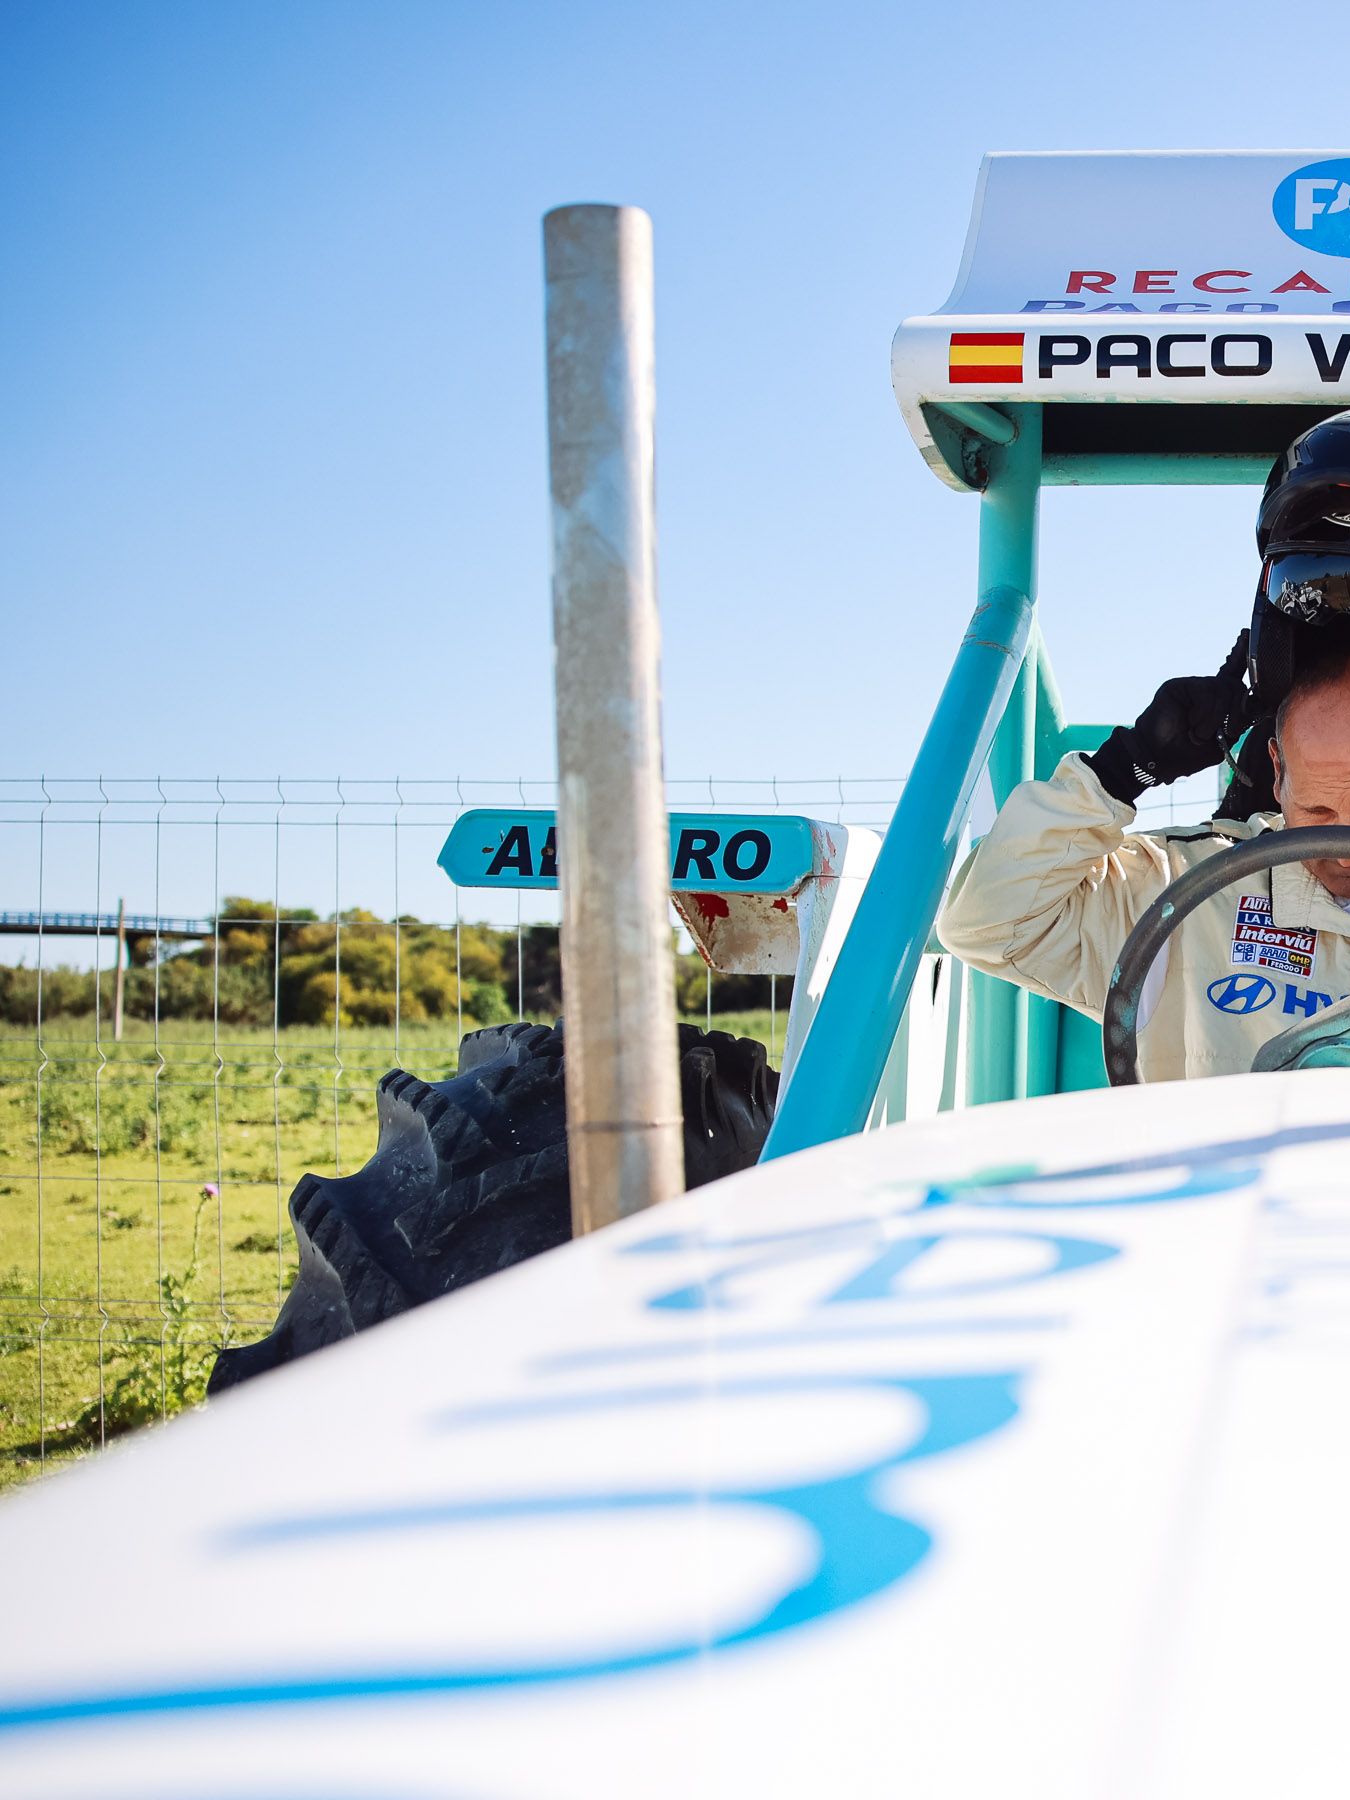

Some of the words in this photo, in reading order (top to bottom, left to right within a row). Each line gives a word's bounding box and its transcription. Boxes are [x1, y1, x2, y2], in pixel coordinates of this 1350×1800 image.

[1019, 300, 1280, 313] PACO
[1038, 333, 1273, 379] PACO
[1245, 914, 1261, 924] LA
[1239, 926, 1313, 951] interviú
[1270, 960, 1300, 973] FERODO
